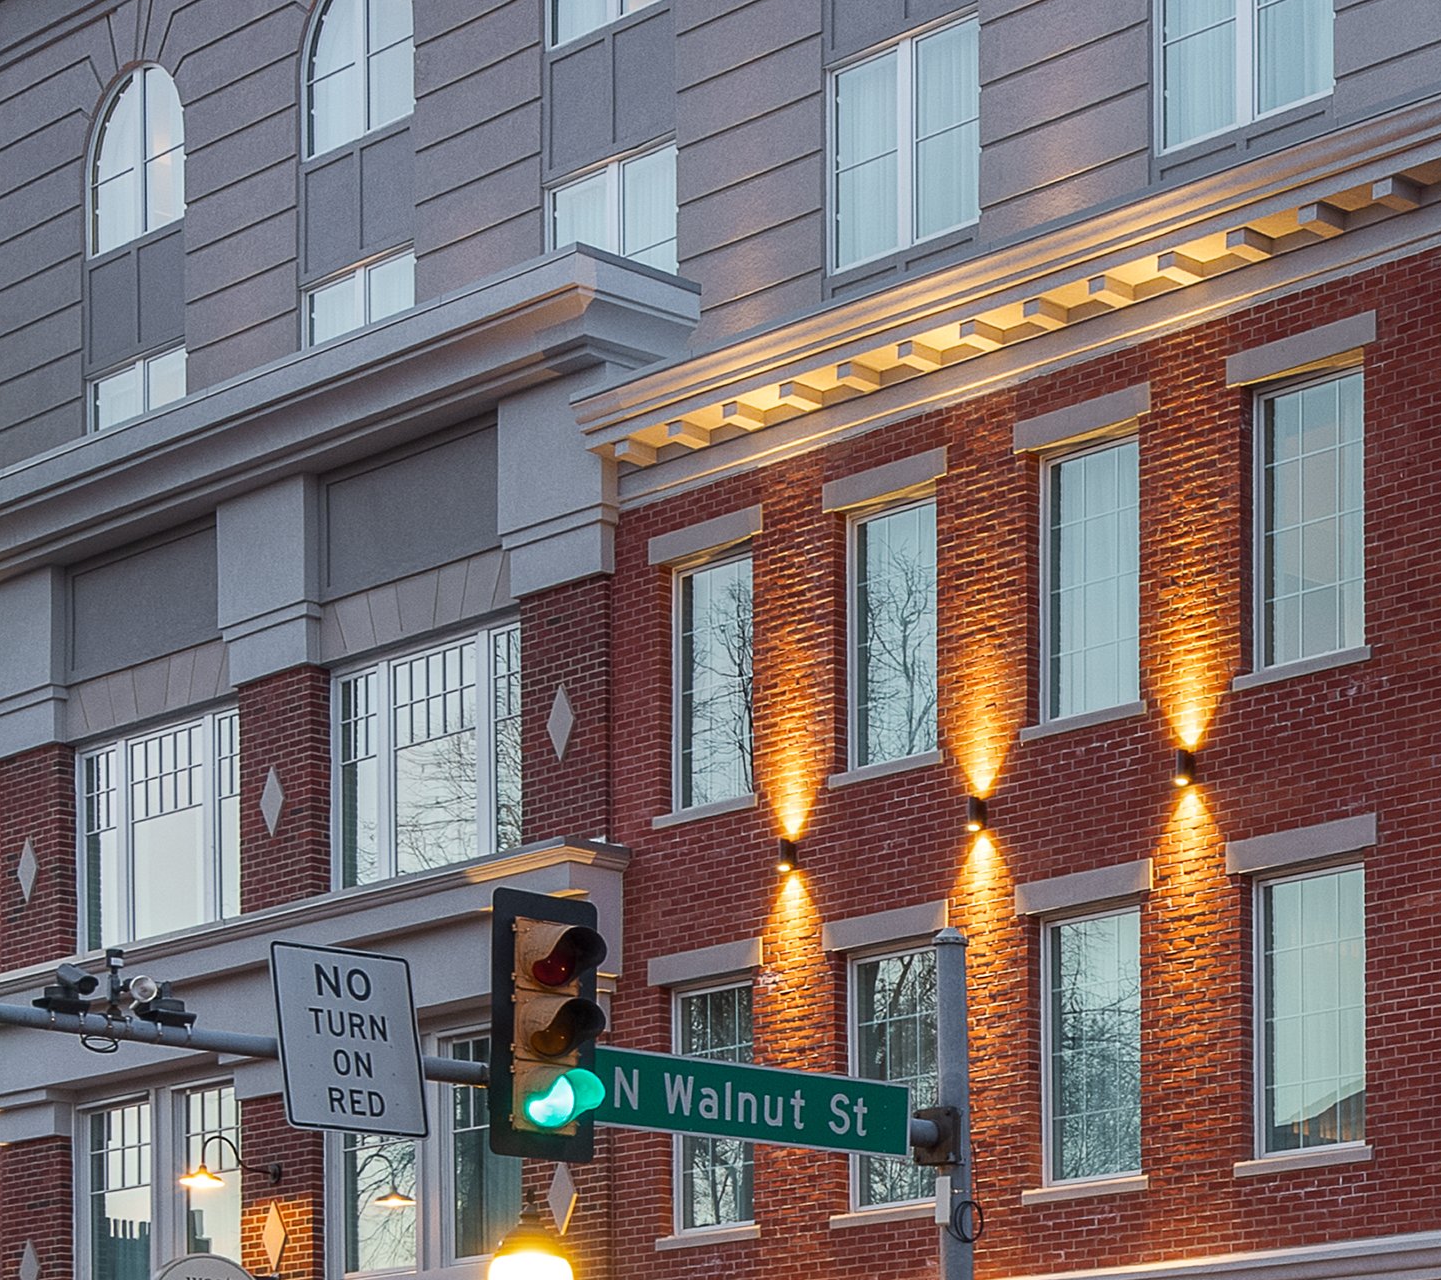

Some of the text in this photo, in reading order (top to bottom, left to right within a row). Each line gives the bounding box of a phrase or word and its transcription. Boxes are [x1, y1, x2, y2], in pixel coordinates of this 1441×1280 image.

[313, 962, 372, 1002] NO
[308, 1007, 388, 1042] TURN
[332, 1048, 374, 1079] ON
[327, 1086, 386, 1118] RED
[613, 1066, 868, 1137] N Walnut St
